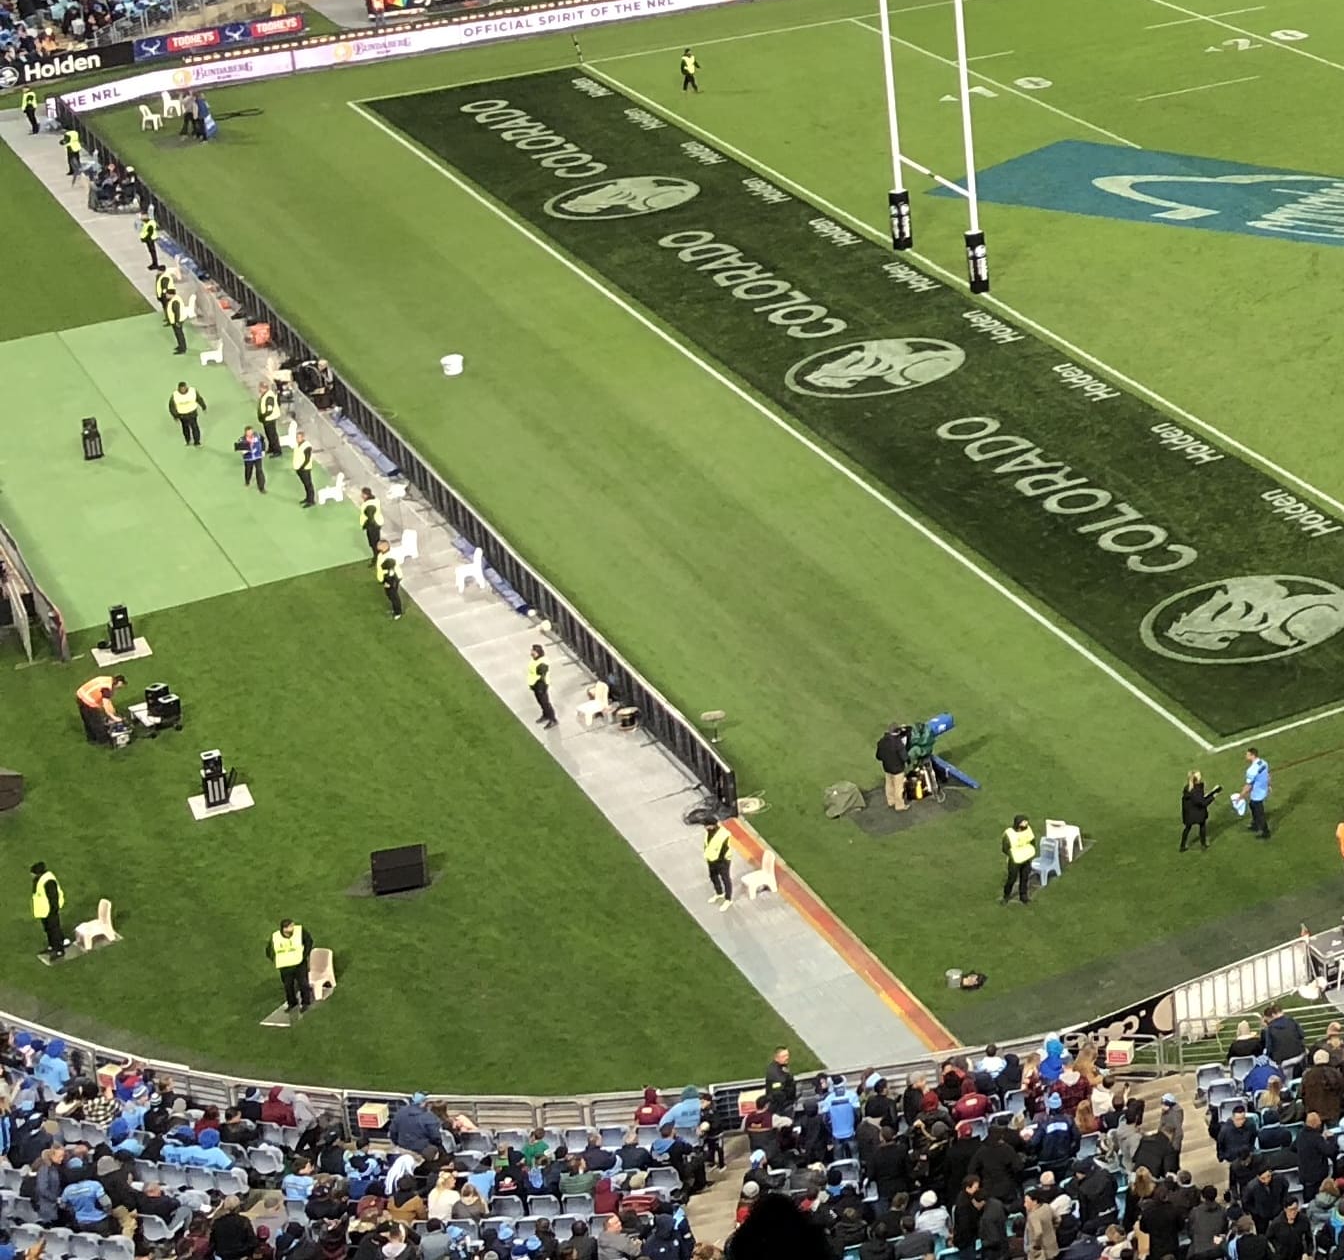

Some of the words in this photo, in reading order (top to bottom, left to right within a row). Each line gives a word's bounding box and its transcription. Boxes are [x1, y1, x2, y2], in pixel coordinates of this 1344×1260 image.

[256, 18, 298, 33] TOOHEYS
[463, 19, 534, 38] OFFICIAL
[538, 10, 586, 26] SPIRIT
[590, 6, 610, 18] OF
[614, 0, 642, 14] THE
[172, 32, 216, 49] TOOHEYS
[352, 37, 412, 56] BUNDABERG
[24, 52, 101, 82] Holden
[194, 60, 253, 82] BUNDABERG
[92, 86, 122, 102] NRL
[572, 77, 613, 98] Holden
[624, 108, 668, 129] Holden
[460, 99, 608, 178] COLORADO
[680, 140, 728, 165] Holden
[742, 176, 793, 204] Holden
[808, 218, 863, 247] Holden
[658, 230, 848, 339] COLORADO
[882, 261, 942, 293] Holden
[961, 309, 1026, 344] Holden
[1052, 362, 1122, 402] Holden
[1151, 421, 1226, 465] Holden
[936, 416, 1198, 574] COLORADO
[1260, 486, 1343, 540] Holden
